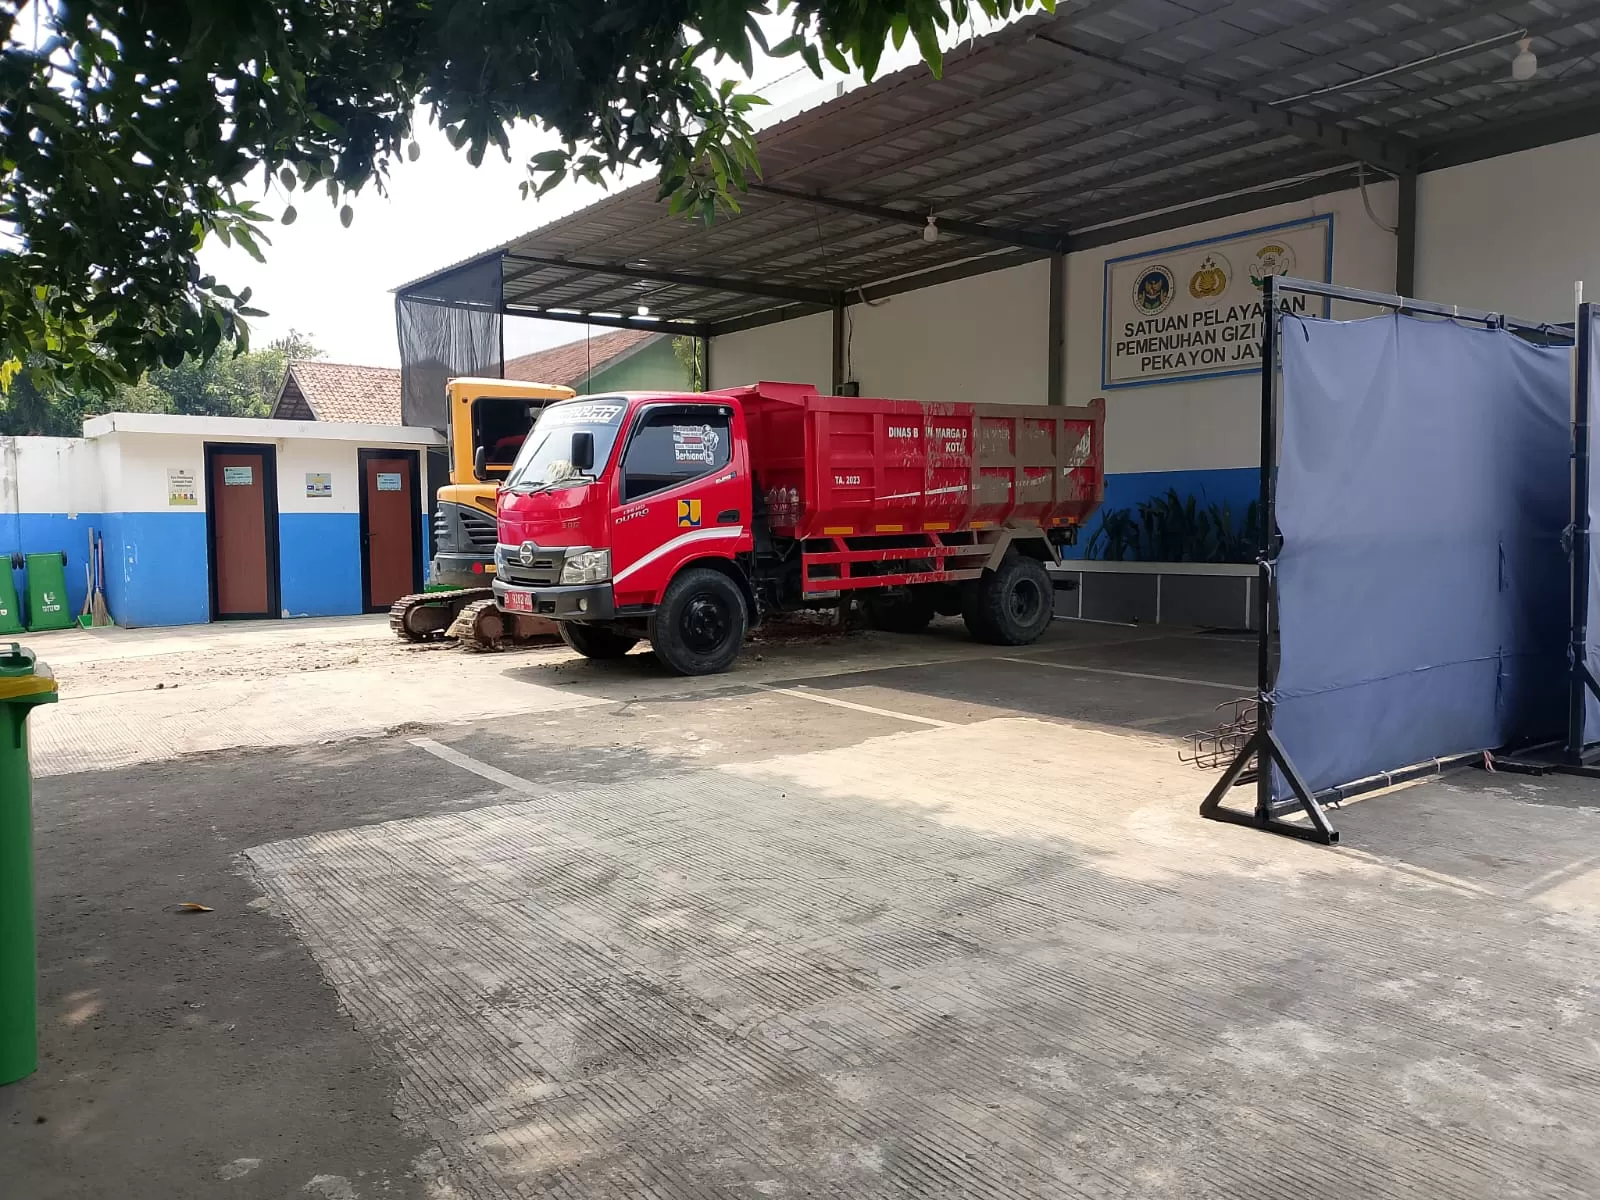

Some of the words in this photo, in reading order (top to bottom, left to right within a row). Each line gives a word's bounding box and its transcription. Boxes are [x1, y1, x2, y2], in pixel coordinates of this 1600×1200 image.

[1124, 313, 1188, 338] SATUAN
[1193, 295, 1306, 328] PELAYAAN
[1116, 328, 1216, 357] PEMENUHAN
[1222, 322, 1256, 342] GIZI
[1141, 346, 1226, 372] PEKAYON
[1231, 342, 1273, 360] JAY
[888, 426, 911, 438] DINAS
[935, 427, 961, 440] MARGA
[834, 475, 845, 485] TA.
[845, 475, 861, 485] 2023
